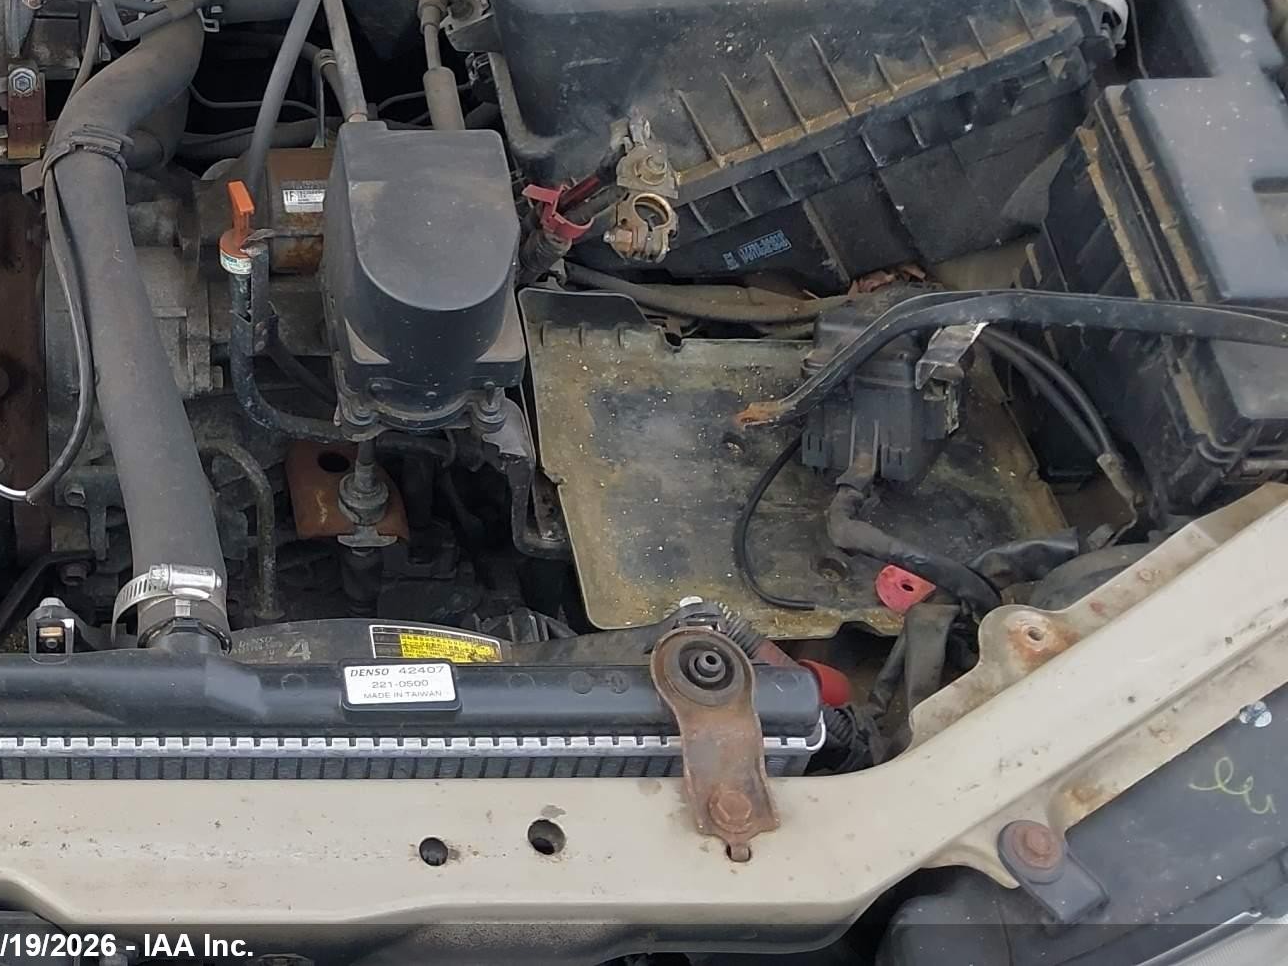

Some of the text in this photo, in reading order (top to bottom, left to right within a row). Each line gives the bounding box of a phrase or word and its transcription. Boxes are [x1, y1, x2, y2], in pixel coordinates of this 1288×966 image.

[350, 665, 444, 677] DENSO 42407
[371, 679, 429, 689] 221-0500
[404, 690, 442, 698] TAIWAN
